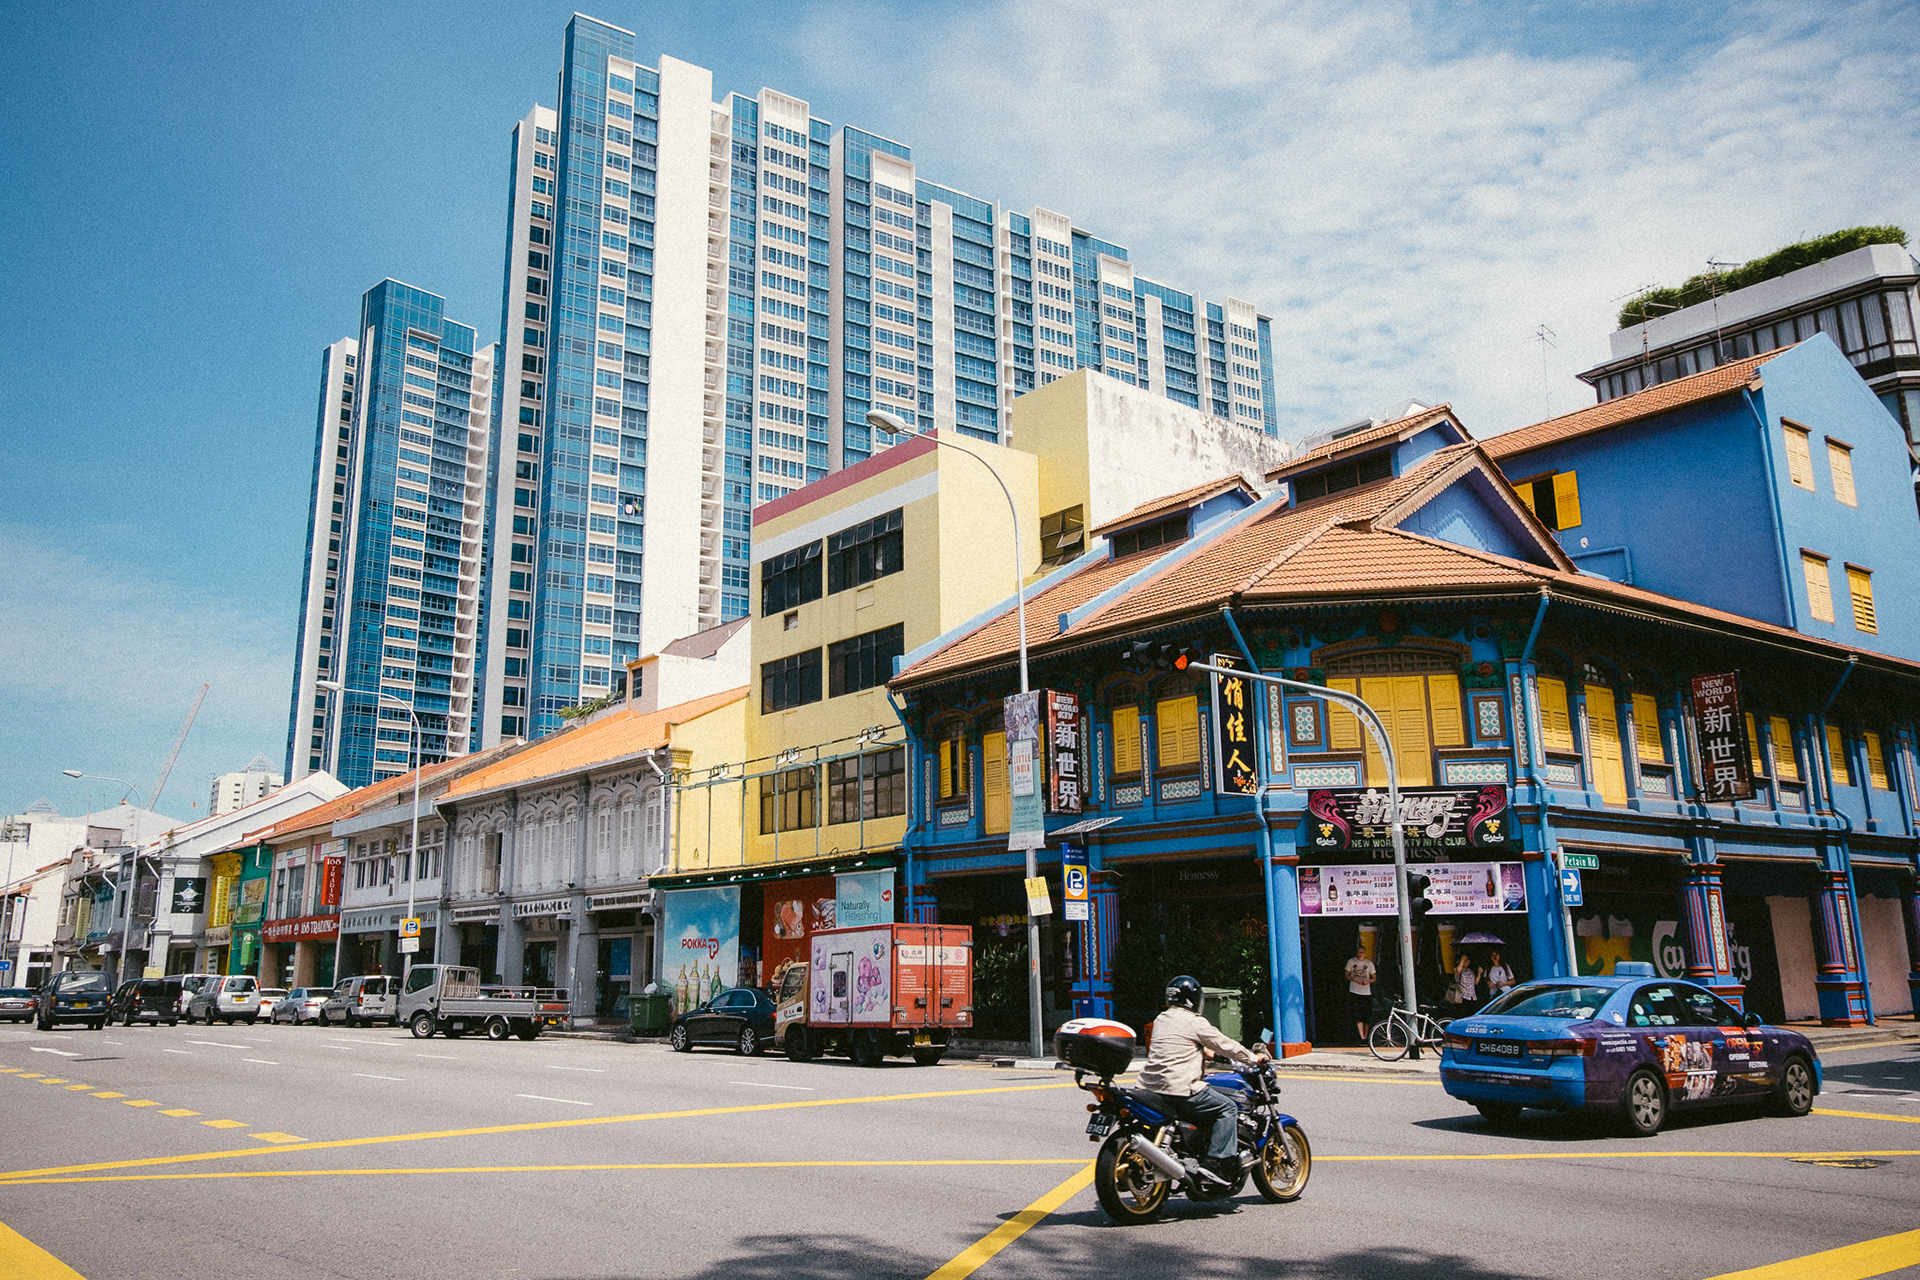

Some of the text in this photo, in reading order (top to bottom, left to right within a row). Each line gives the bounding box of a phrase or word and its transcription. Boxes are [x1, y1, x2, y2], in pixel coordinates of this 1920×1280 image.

[1701, 678, 1724, 689] NEW
[1696, 685, 1732, 698] WORLD
[1055, 695, 1074, 705] NEW
[1705, 695, 1725, 705] KTV
[1051, 702, 1079, 713] WORLD
[1057, 711, 1074, 720] KTV
[1224, 677, 1251, 772] 俏佳人
[1703, 705, 1741, 795] 新世界
[1014, 753, 1031, 765] LITTLE
[1055, 721, 1080, 808] 新世界
[1014, 763, 1030, 774] INDIA
[1351, 838, 1370, 848] NEW
[1423, 838, 1442, 847] NITE
[1444, 837, 1466, 846] CLUB
[1564, 855, 1596, 867] Petain Rd
[1179, 869, 1219, 882] Hennessy
[1564, 894, 1573, 902] ONE
[841, 900, 870, 911] Naturally
[845, 911, 879, 922] Refreshing
[310, 920, 334, 935] TRADING
[681, 939, 707, 949] POKKA
[1479, 1042, 1520, 1055] SH6408B
[1728, 1053, 1750, 1061] OPENING
